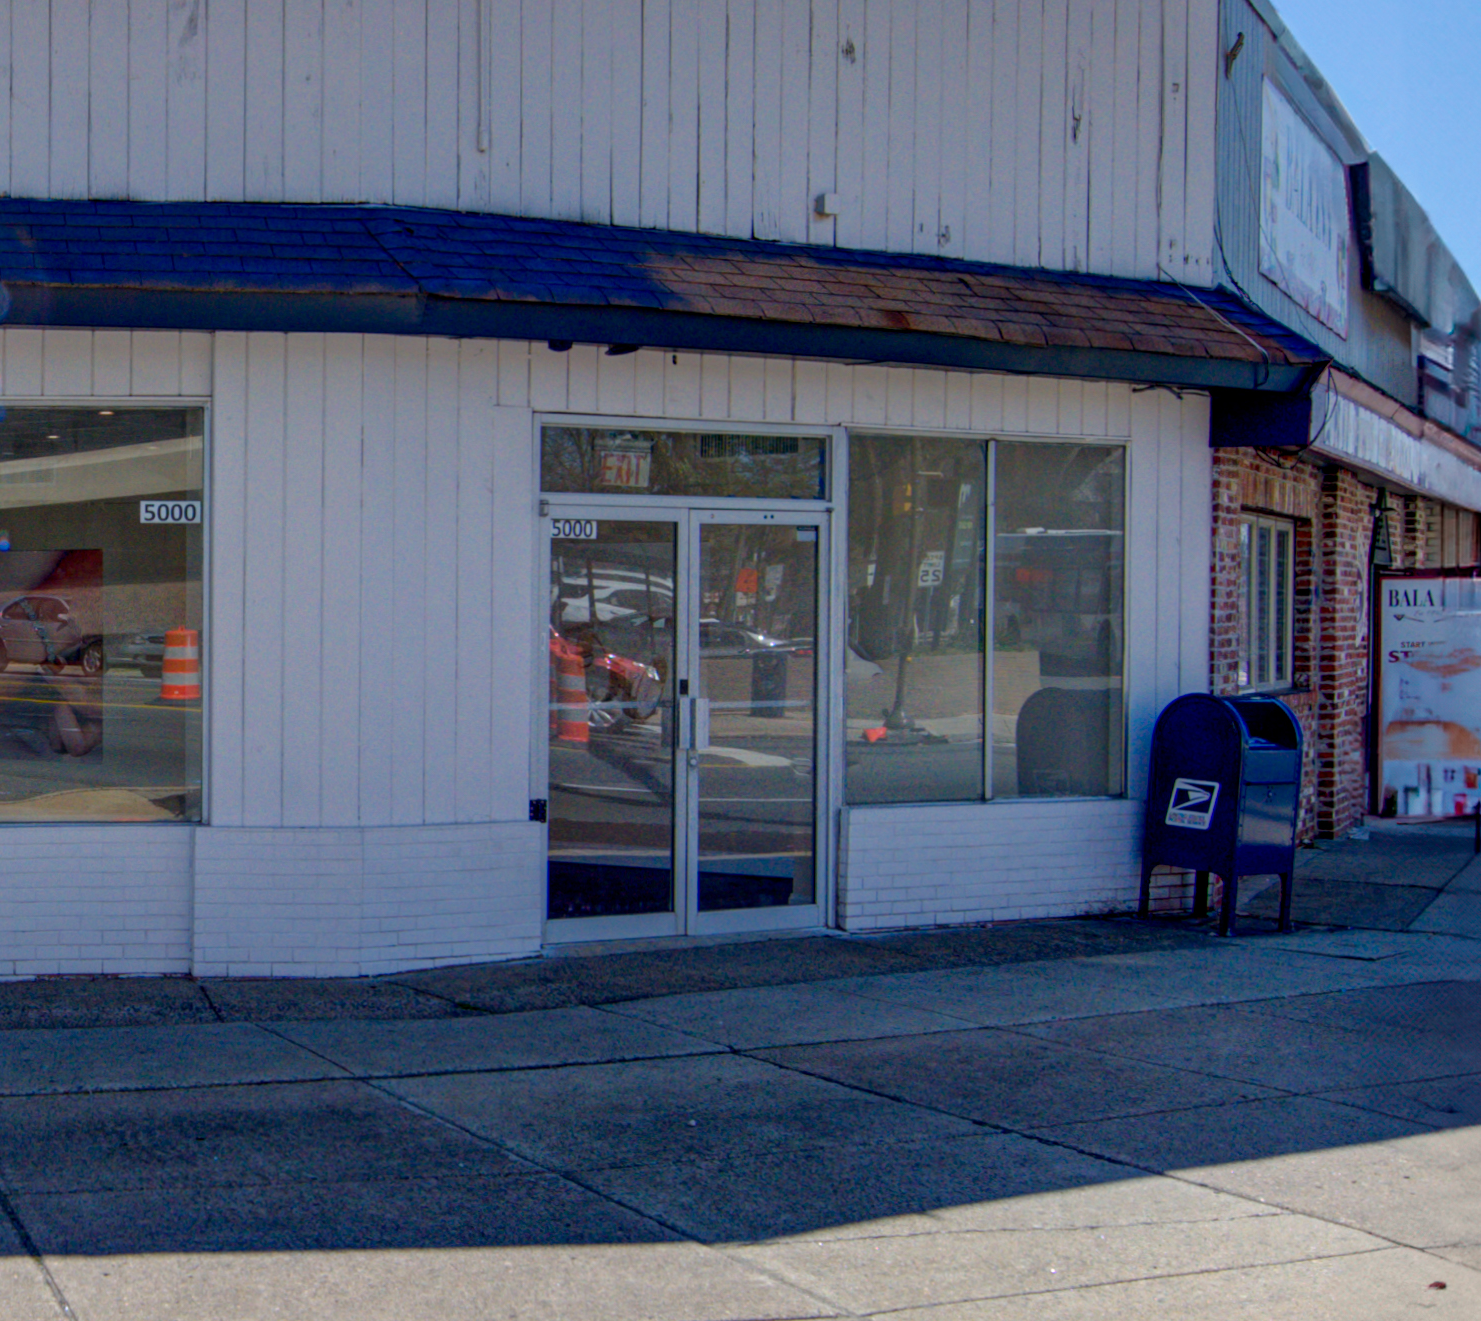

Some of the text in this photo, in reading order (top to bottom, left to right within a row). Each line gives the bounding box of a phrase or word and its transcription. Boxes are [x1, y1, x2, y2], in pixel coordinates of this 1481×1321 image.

[144, 503, 197, 522] 5000
[551, 519, 594, 538] 5000
[1388, 589, 1435, 608] BALA
[1400, 641, 1426, 649] START
